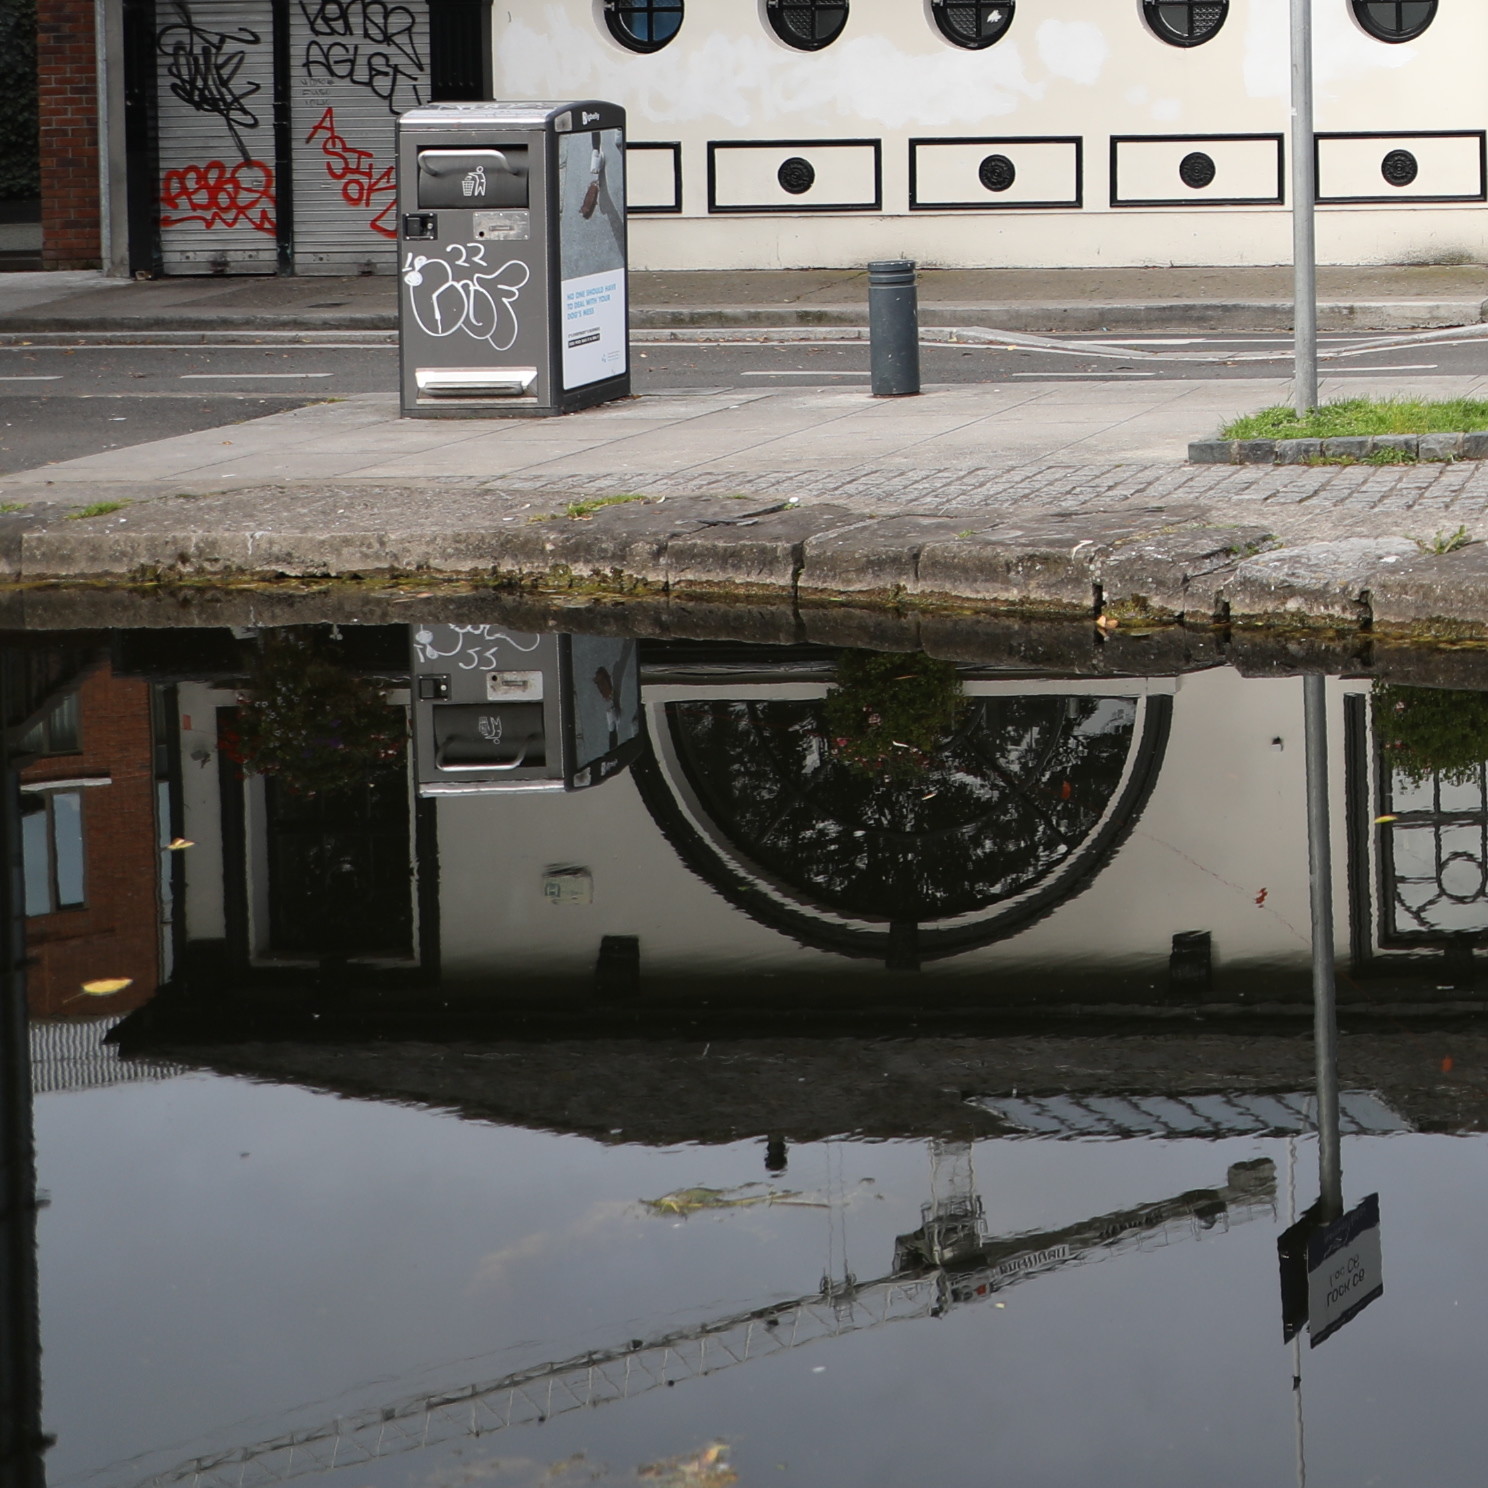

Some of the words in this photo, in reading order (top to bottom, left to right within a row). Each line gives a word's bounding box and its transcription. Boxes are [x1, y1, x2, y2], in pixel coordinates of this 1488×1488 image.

[586, 286, 604, 297] SHOULD
[586, 297, 597, 306] WITH
[598, 294, 610, 302] YOUR
